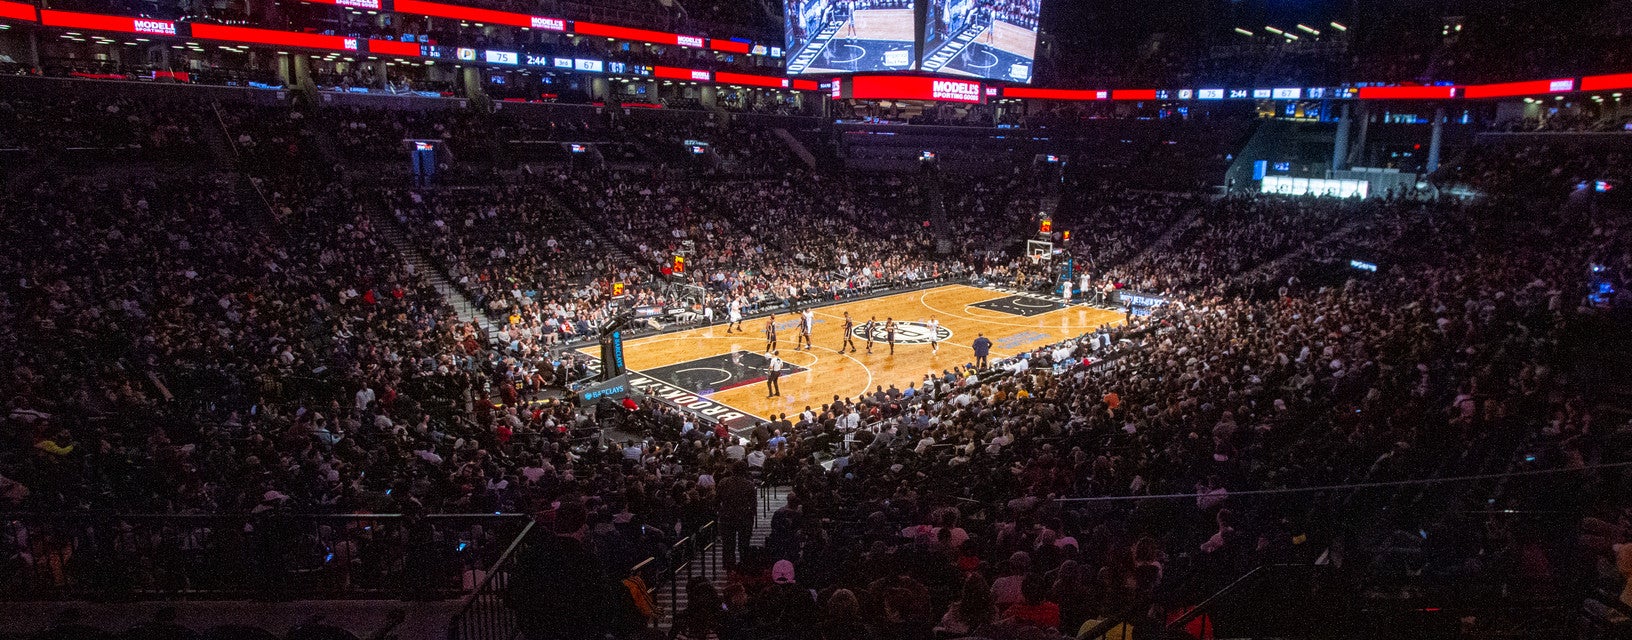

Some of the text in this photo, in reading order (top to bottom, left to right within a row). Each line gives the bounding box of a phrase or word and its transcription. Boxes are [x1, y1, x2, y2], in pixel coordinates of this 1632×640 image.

[496, 53, 508, 62] 75
[527, 56, 545, 66] 2:44
[583, 62, 594, 70] 67
[933, 80, 979, 95] MODELL'S
[932, 91, 963, 100] SPORTING
[1230, 90, 1247, 98] 2:44
[613, 339, 624, 368] BARCLAYS
[629, 377, 745, 422] BROOKLYN
